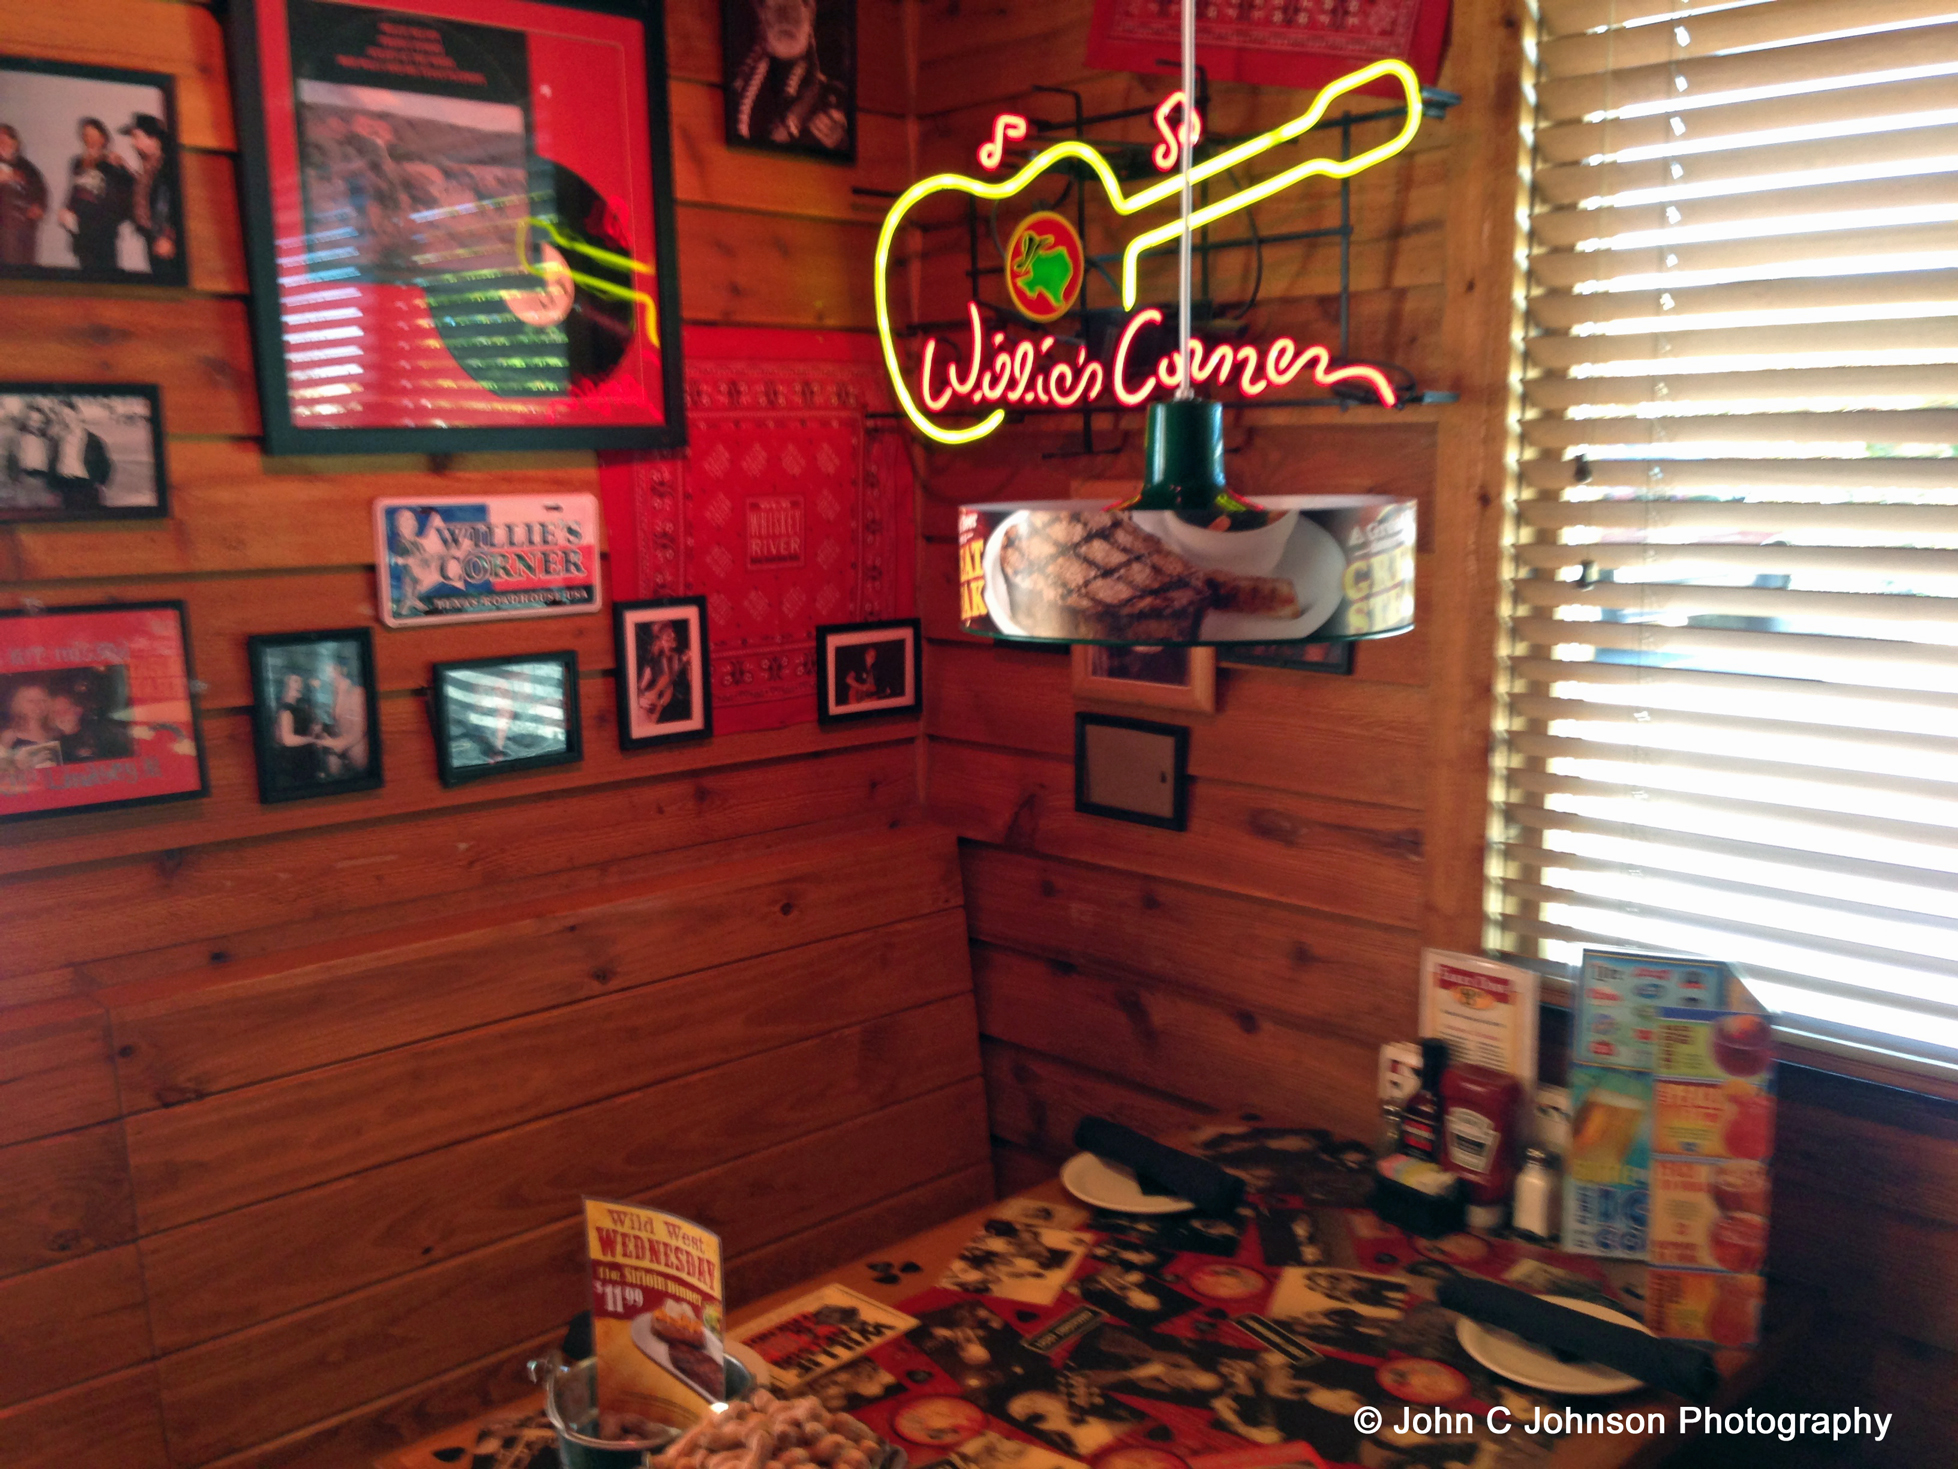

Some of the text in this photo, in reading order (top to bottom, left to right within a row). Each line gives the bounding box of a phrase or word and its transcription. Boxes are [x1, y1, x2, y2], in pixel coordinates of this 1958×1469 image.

[921, 302, 1397, 412] Willie's Corner
[435, 520, 584, 551] WILLIE'S
[751, 537, 801, 556] RIVER
[440, 549, 588, 583] CORNER
[607, 1208, 705, 1253] Wild West
[596, 1226, 717, 1291] WEDNESDAY
